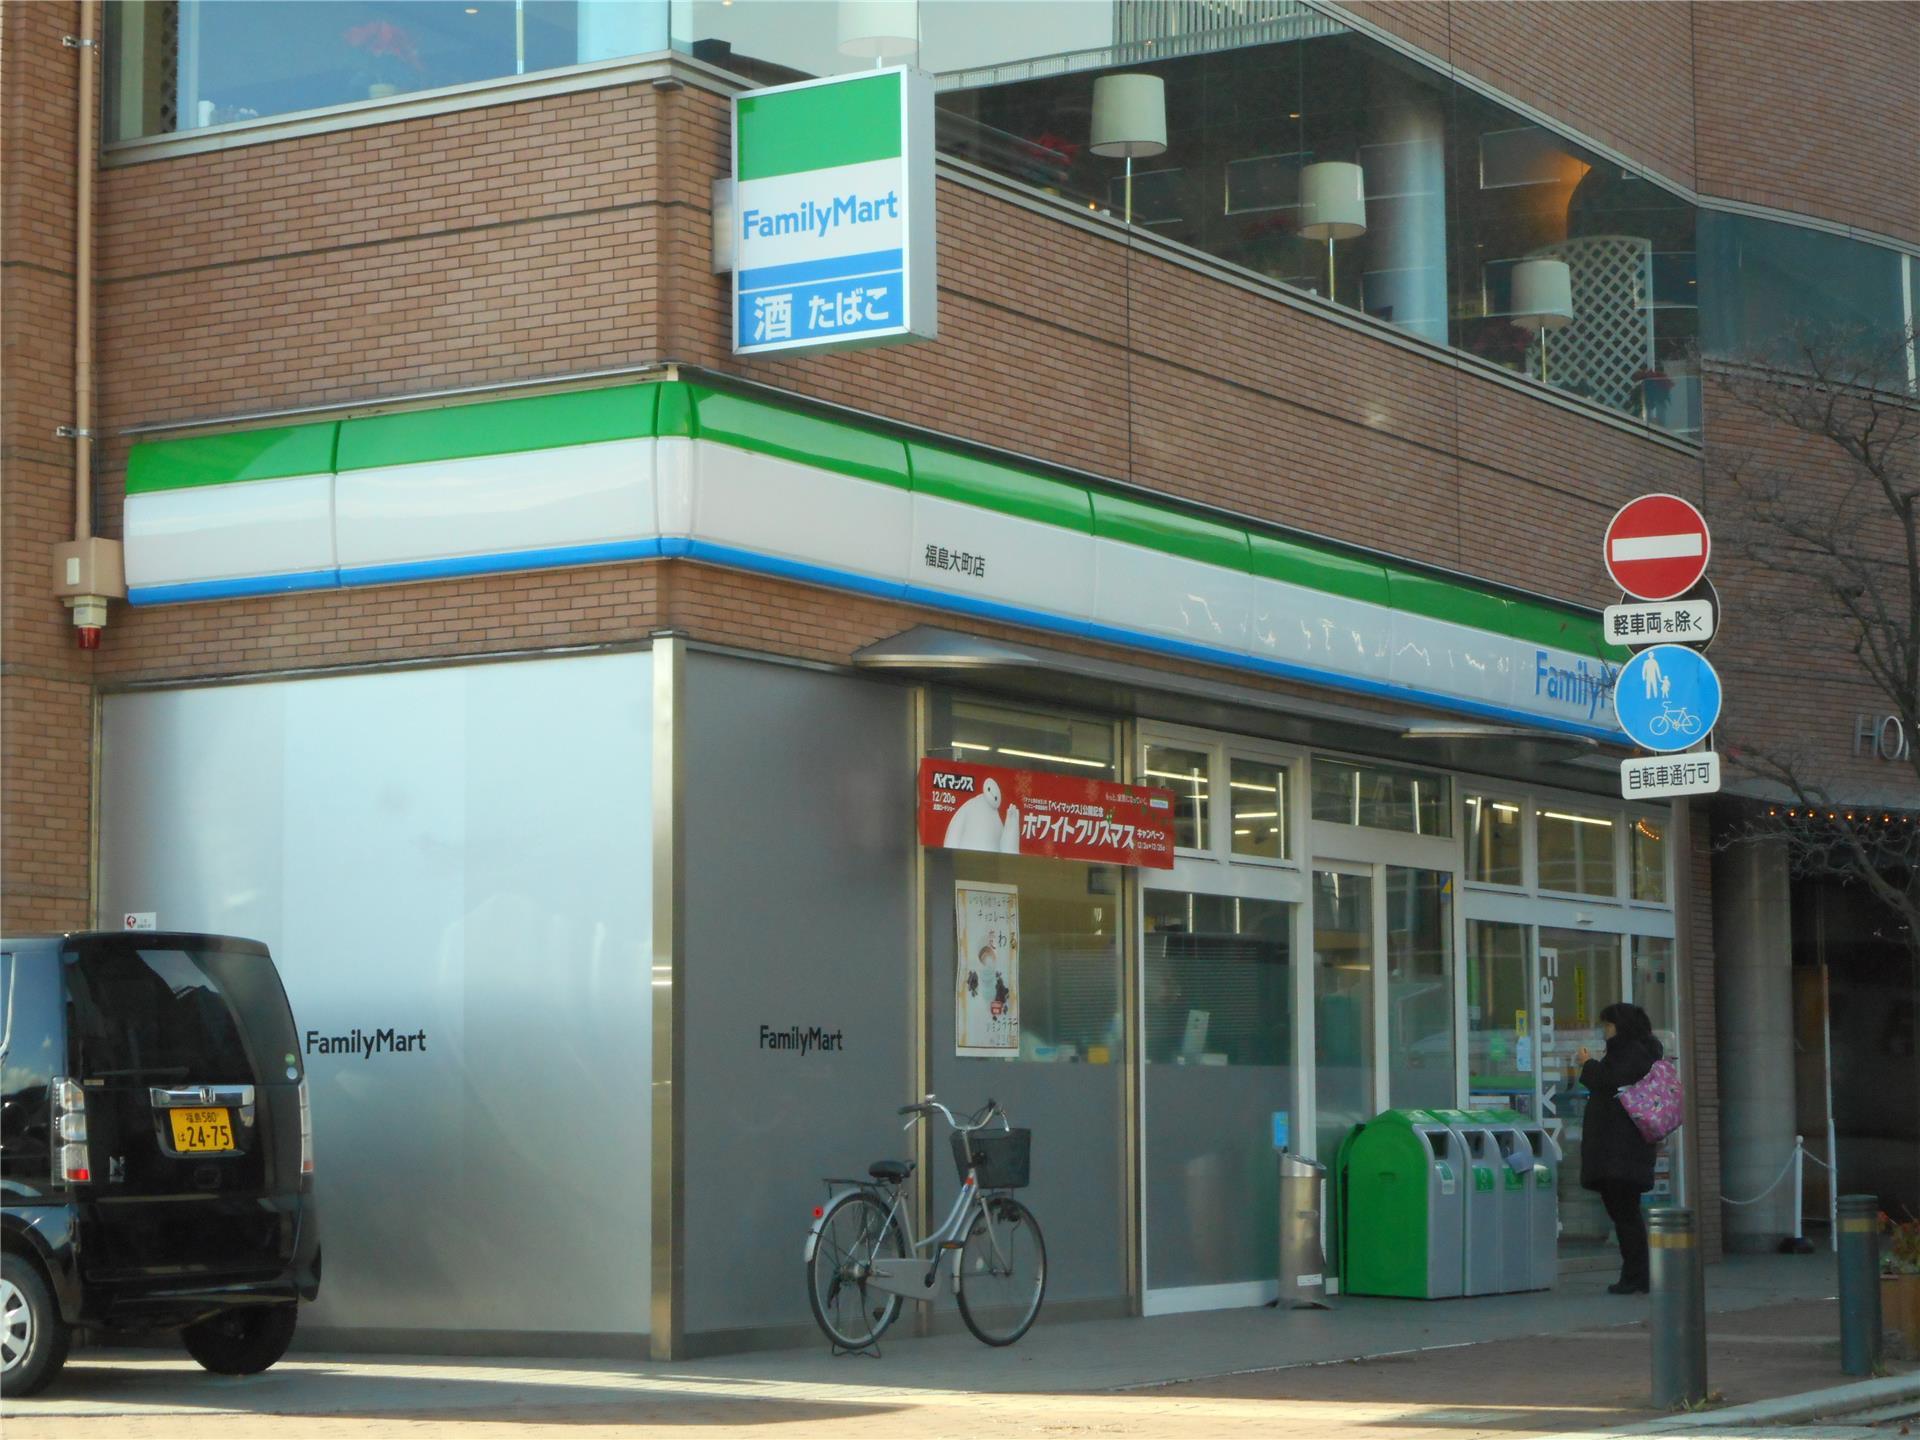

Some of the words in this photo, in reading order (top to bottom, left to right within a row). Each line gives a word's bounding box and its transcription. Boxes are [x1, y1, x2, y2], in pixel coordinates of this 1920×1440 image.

[743, 190, 898, 240] FamilyMart
[754, 293, 793, 341] 酒
[808, 287, 889, 330] たばこ
[925, 544, 986, 578] 福島大町店
[1613, 610, 1703, 636] 軽車両を除く
[1536, 650, 1618, 720] FamilyM
[1854, 714, 1910, 761] HO
[933, 772, 974, 791] ベイマックス
[1629, 762, 1710, 790] 自転車通行可
[1022, 813, 1136, 850] ホワイトクリスマス
[306, 1028, 426, 1060] FamilyMart
[760, 1025, 843, 1056] FamilyMart
[187, 1126, 230, 1147] 24-75
